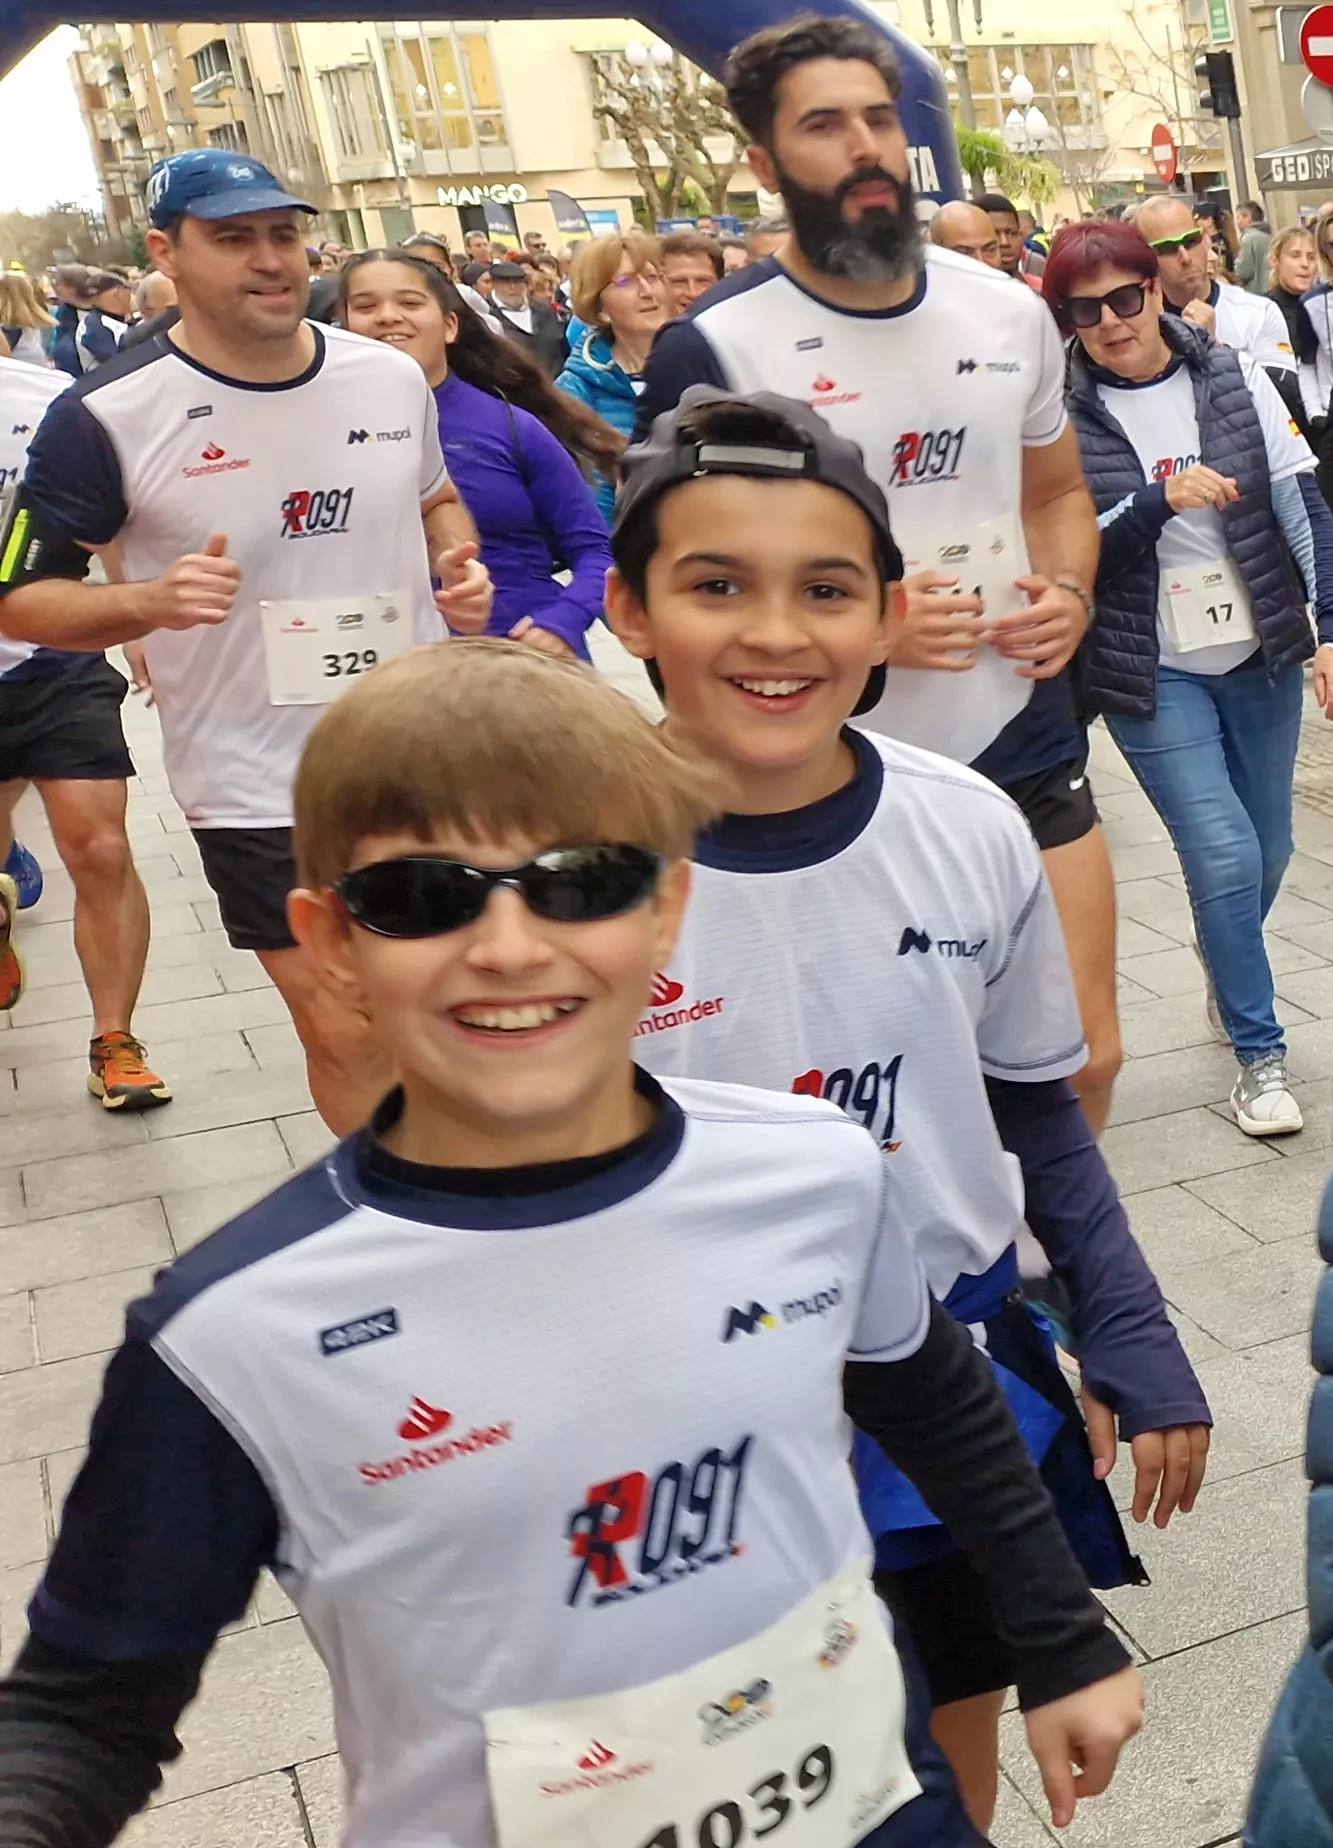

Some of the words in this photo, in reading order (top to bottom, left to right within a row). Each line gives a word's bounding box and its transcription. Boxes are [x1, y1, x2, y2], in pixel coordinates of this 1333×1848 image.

[905, 146, 941, 193] TA
[437, 183, 528, 206] MANGO
[182, 457, 250, 479] Santander
[1206, 603, 1234, 625] 17
[322, 650, 378, 678] 329
[632, 997, 724, 1037] ntander
[358, 1421, 514, 1486] Santander
